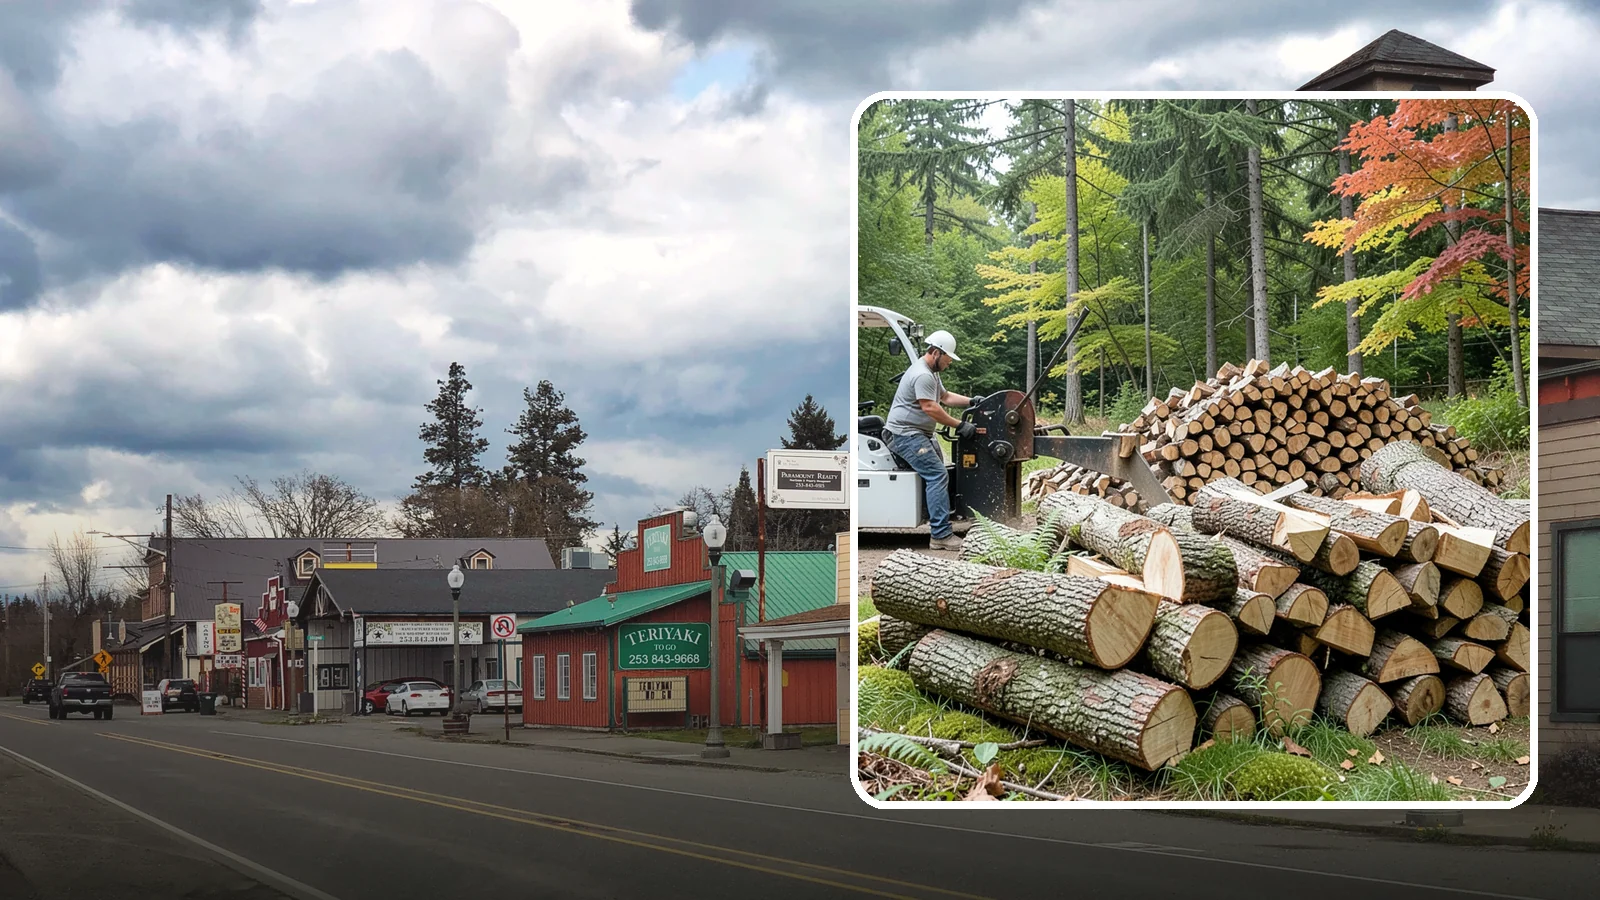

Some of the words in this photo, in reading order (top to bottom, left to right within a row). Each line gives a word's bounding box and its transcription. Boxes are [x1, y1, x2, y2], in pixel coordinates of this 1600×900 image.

[781, 471, 814, 479] PARAMOUNT
[817, 472, 838, 480] REALTY
[624, 627, 702, 646] TERIYAKI
[628, 654, 648, 664] 253
[651, 654, 700, 664] 843-9668
